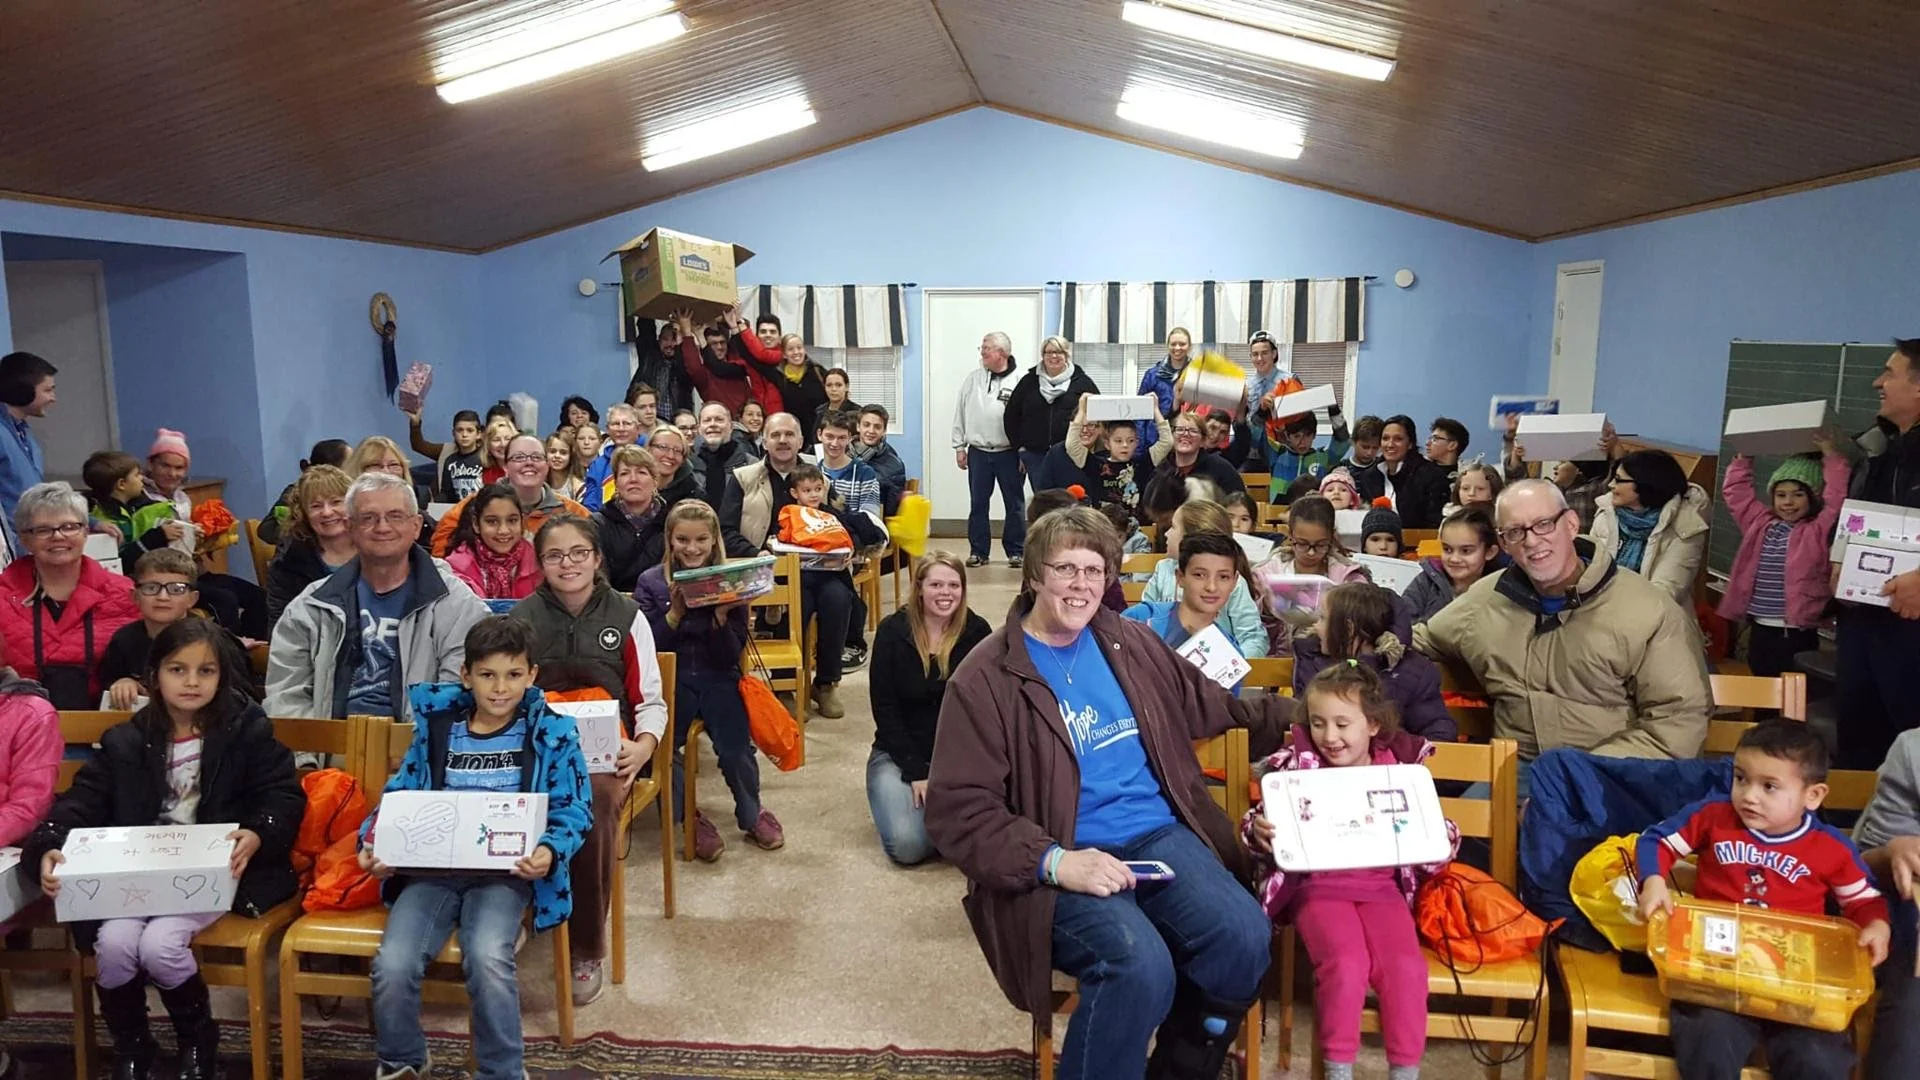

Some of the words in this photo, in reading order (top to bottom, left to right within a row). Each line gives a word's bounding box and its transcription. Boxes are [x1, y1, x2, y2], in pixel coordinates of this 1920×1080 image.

[1059, 699, 1098, 756] Hope
[1091, 721, 1119, 740] CHANGES
[1714, 840, 1812, 884] MICKEY
